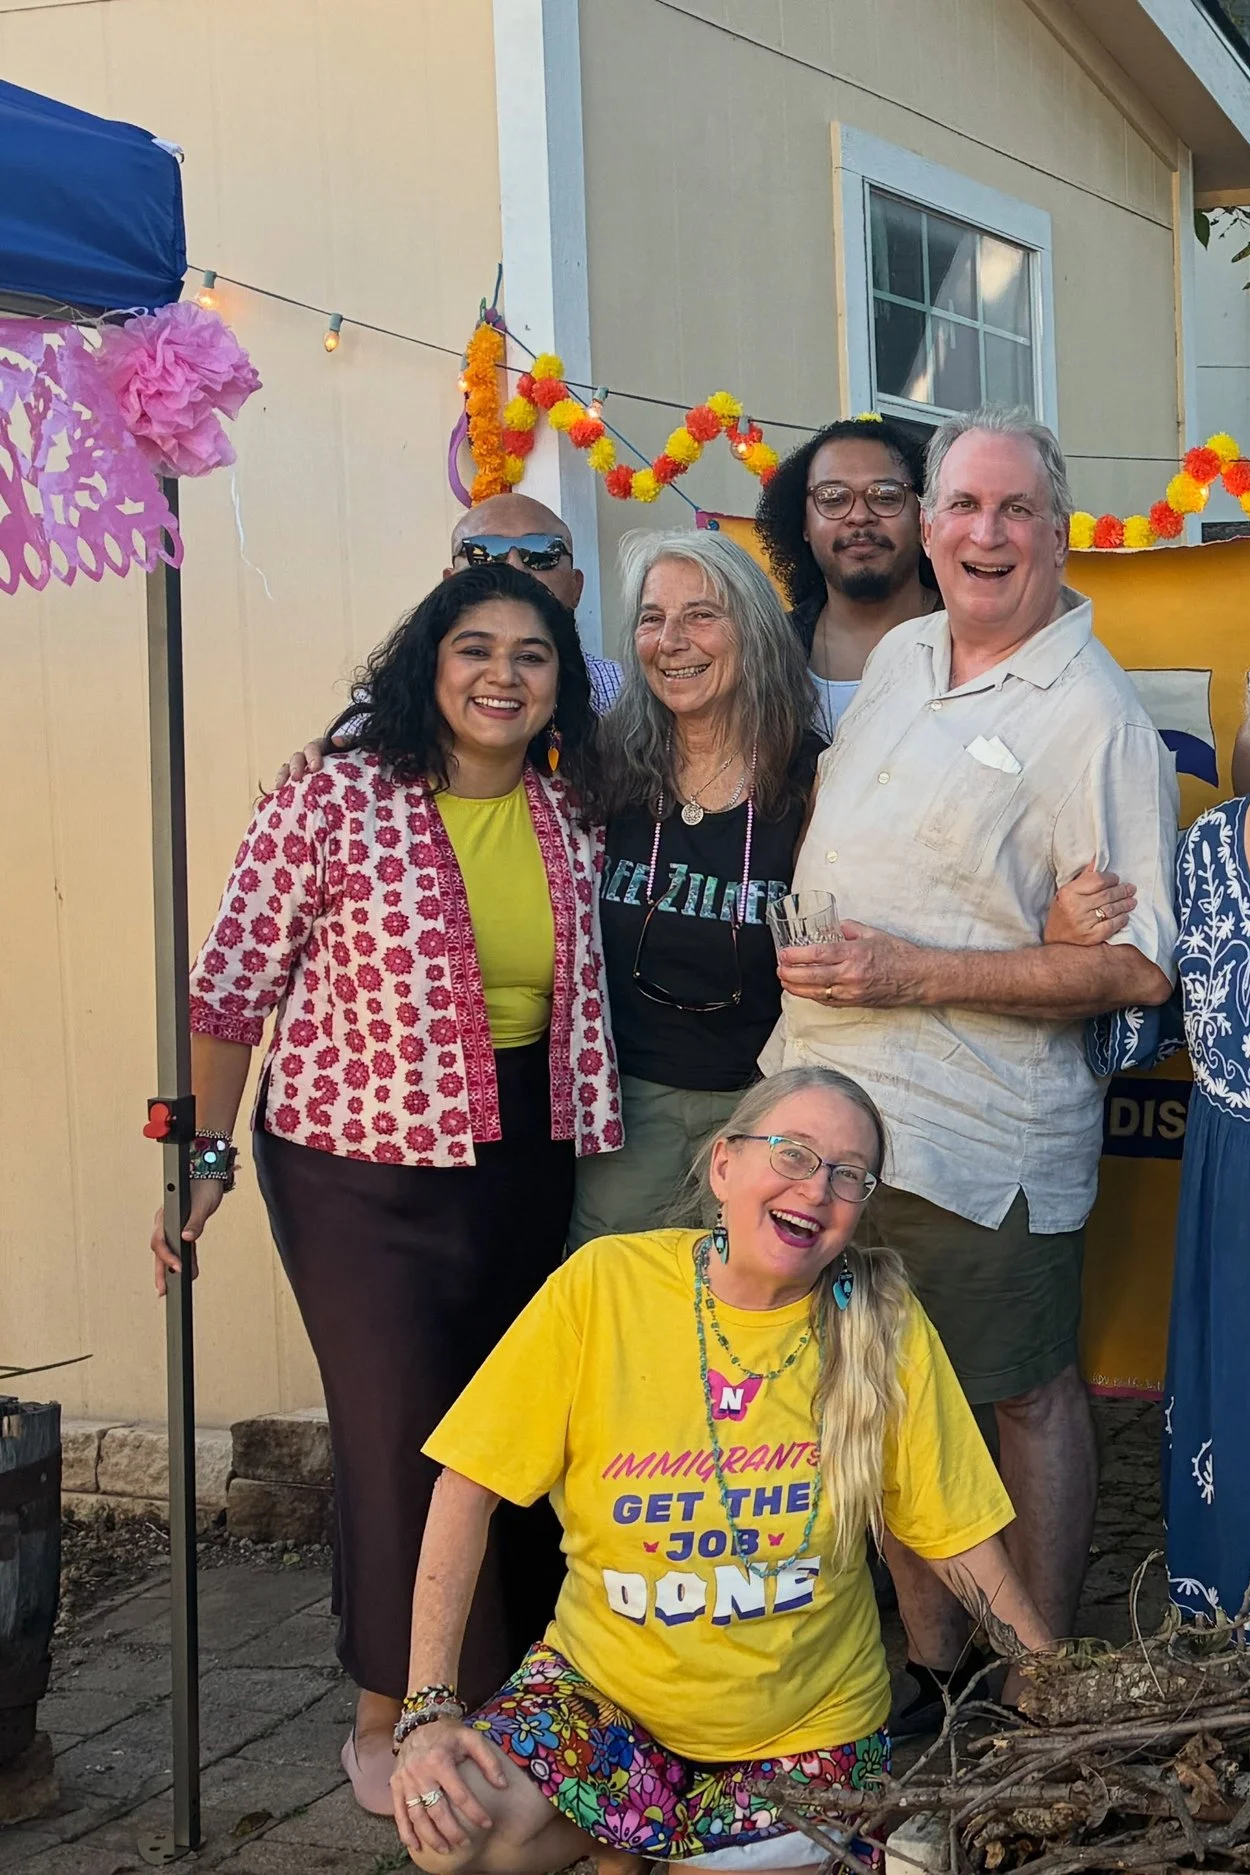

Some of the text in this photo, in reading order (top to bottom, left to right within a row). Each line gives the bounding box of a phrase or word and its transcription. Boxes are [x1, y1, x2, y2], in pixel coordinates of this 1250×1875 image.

[600, 855, 651, 906] EE
[718, 1386, 744, 1413] N
[602, 1441, 821, 1483] IMMIGRANTS
[612, 1482, 811, 1525] GET THE
[666, 1529, 760, 1561] JOB
[602, 1556, 821, 1627] DONE
